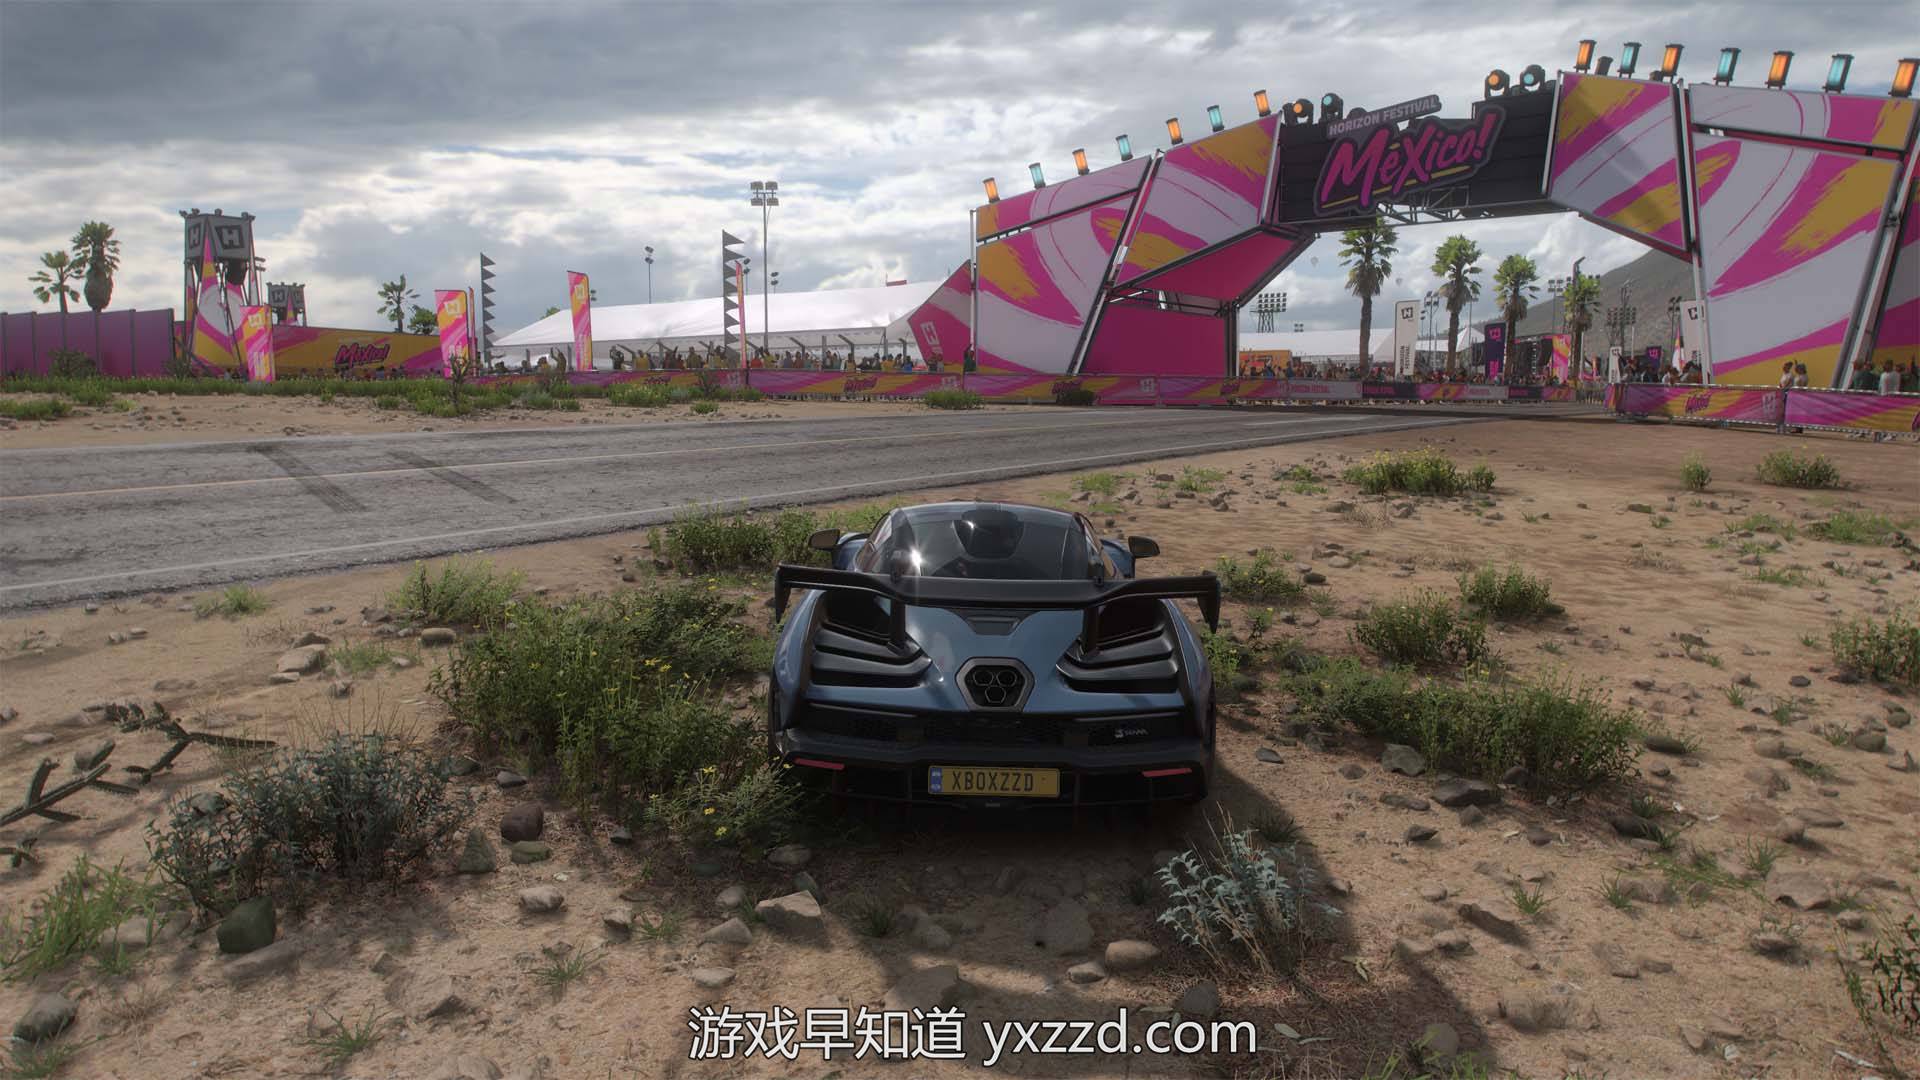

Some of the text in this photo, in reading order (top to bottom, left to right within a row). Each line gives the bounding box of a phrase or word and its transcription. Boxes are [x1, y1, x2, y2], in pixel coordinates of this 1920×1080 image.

[1328, 95, 1438, 136] HORIZON FESTIVAL
[951, 770, 1034, 792] XBOXZZD
